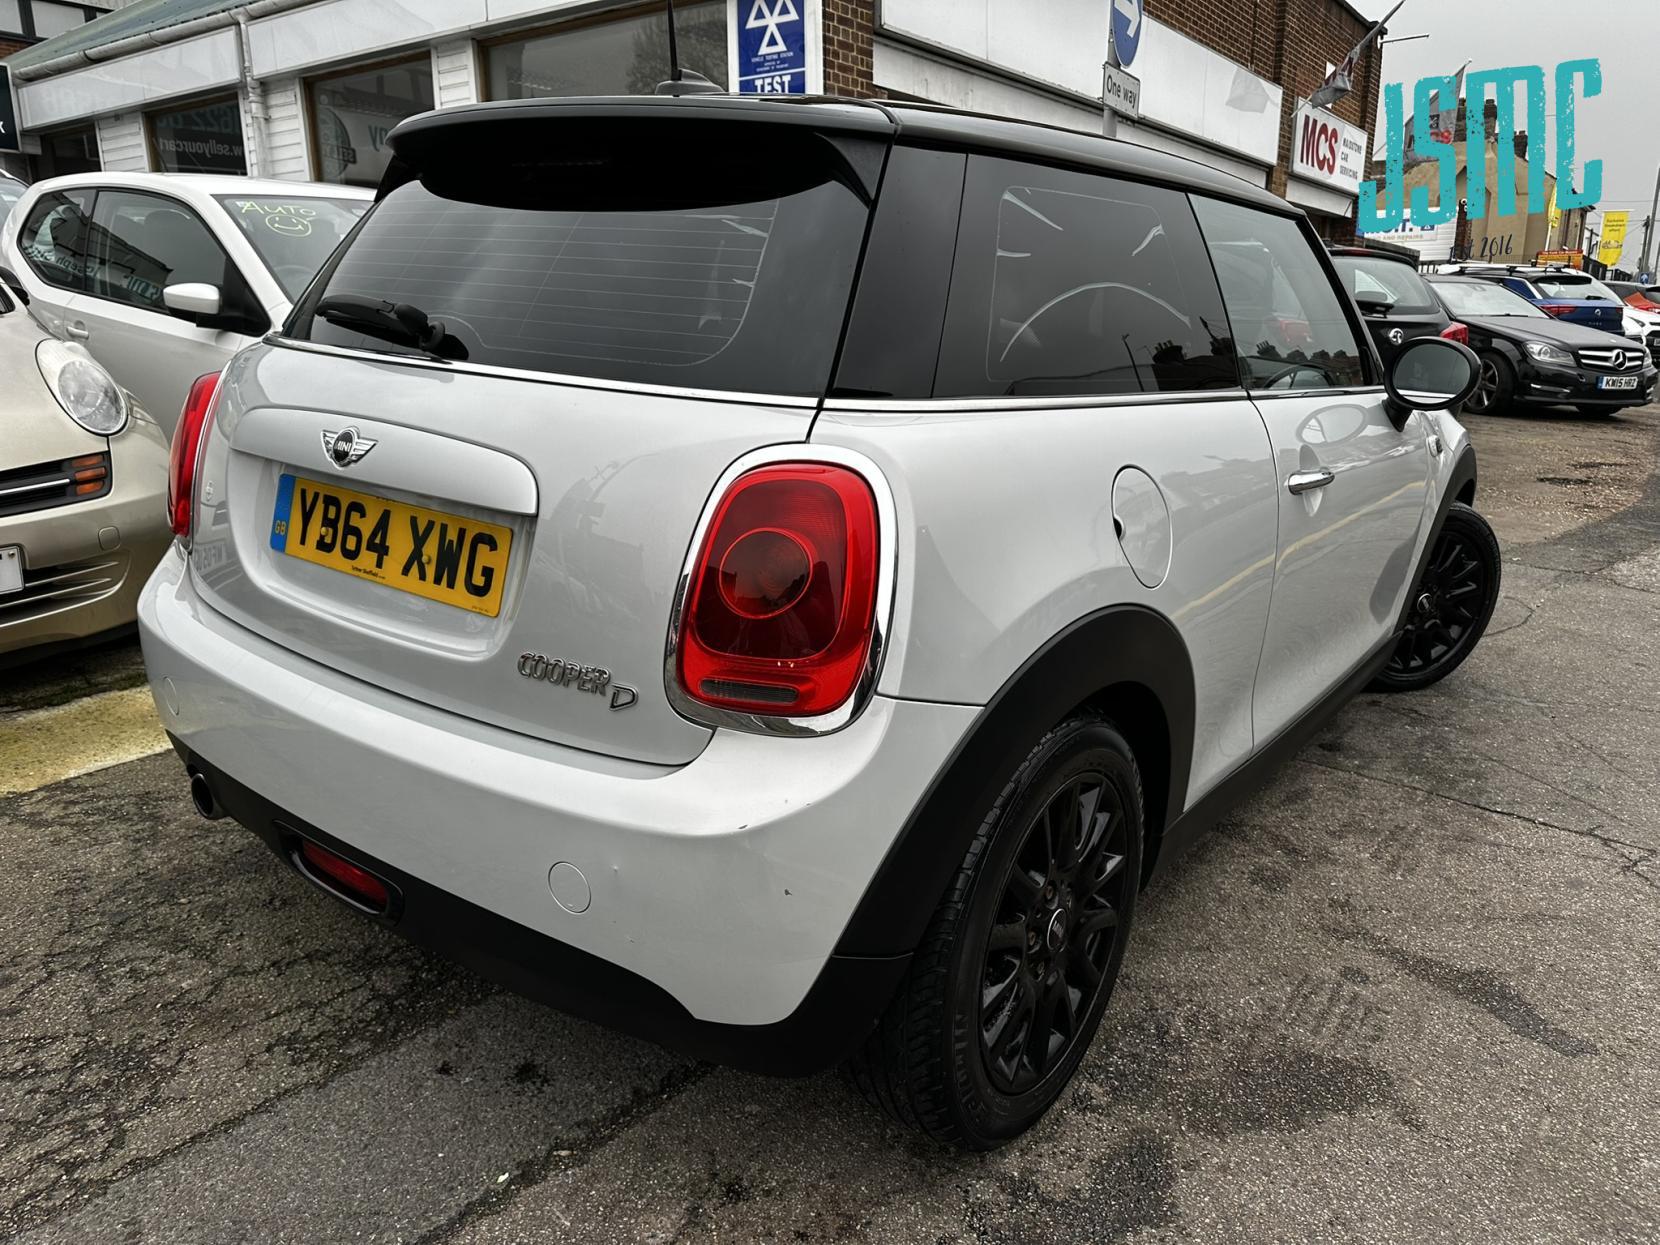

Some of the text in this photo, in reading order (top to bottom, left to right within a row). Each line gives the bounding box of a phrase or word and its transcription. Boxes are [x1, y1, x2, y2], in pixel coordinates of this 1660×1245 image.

[755, 75, 791, 93] TEST
[1107, 75, 1137, 109] One way
[1300, 114, 1338, 175] MCS
[1341, 151, 1349, 163] CAR
[1480, 233, 1513, 258] 2016
[274, 519, 287, 536] GB
[299, 487, 498, 598] YB64 XWG
[518, 651, 639, 712] COOPER D
